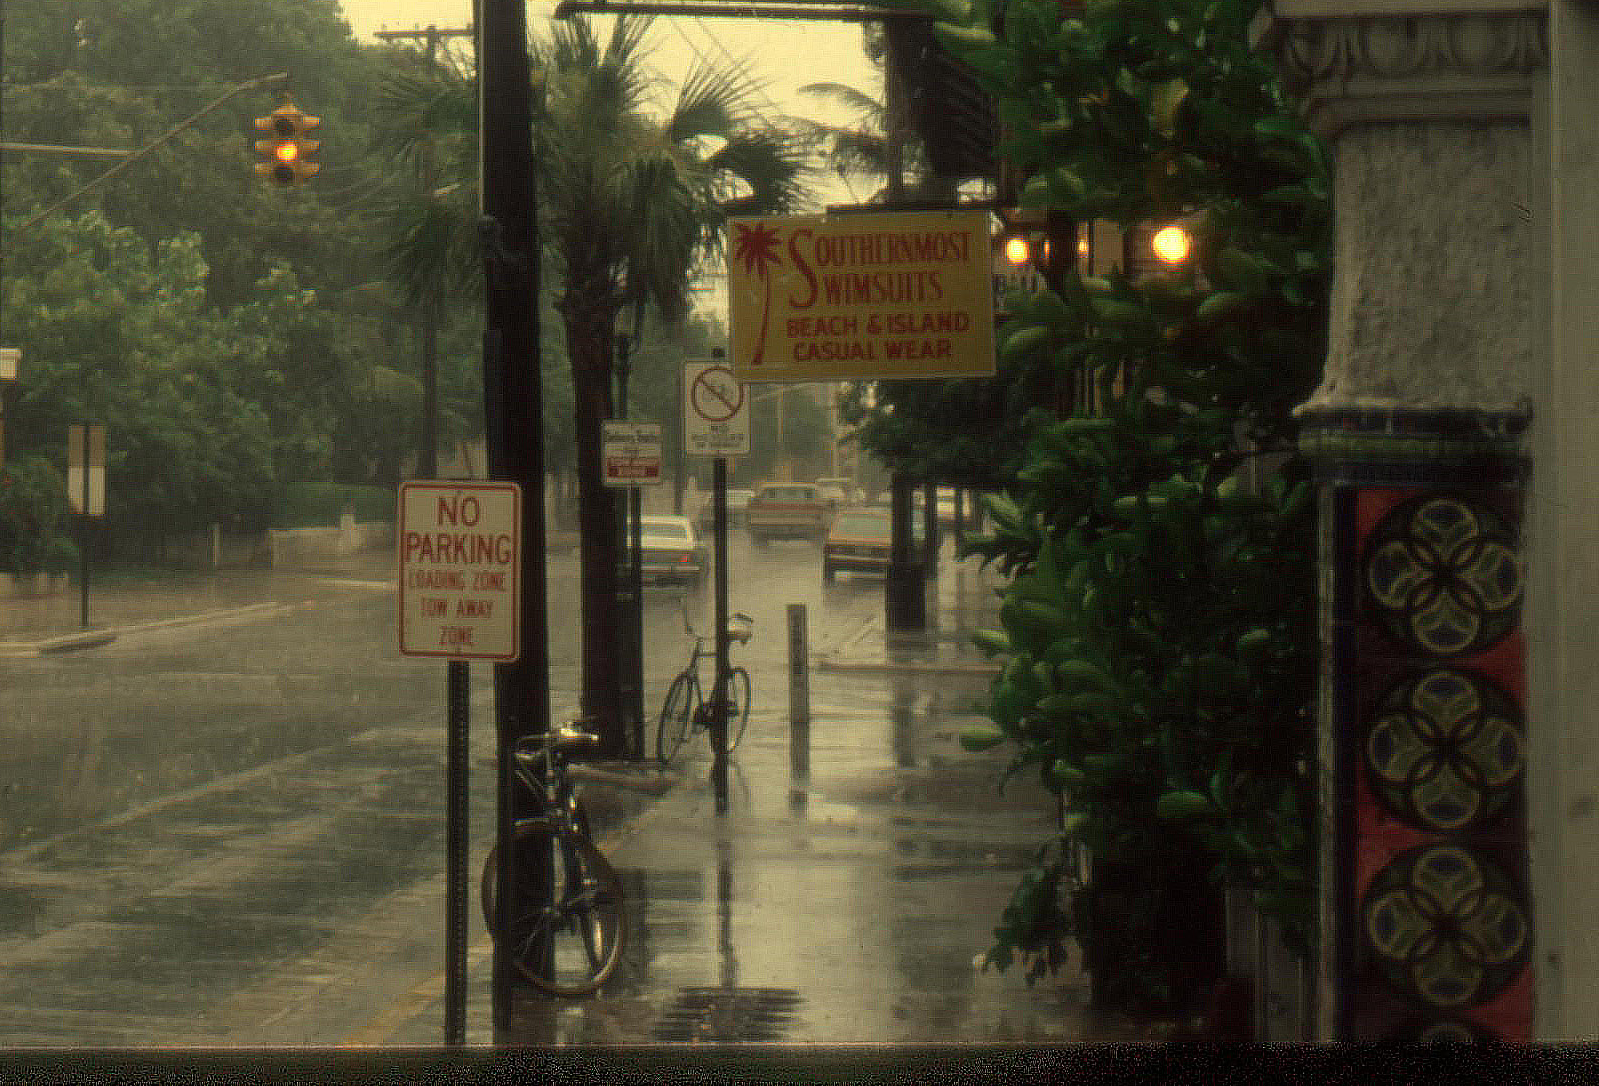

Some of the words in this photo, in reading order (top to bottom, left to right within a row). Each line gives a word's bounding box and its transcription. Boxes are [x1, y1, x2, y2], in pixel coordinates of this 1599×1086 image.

[786, 318, 858, 338] BEACH
[866, 315, 881, 334] &
[888, 313, 969, 333] ISLAND
[794, 342, 876, 361] CASUAL
[884, 340, 951, 359] WEAR
[438, 497, 480, 526] NO
[405, 533, 512, 563] PARKING
